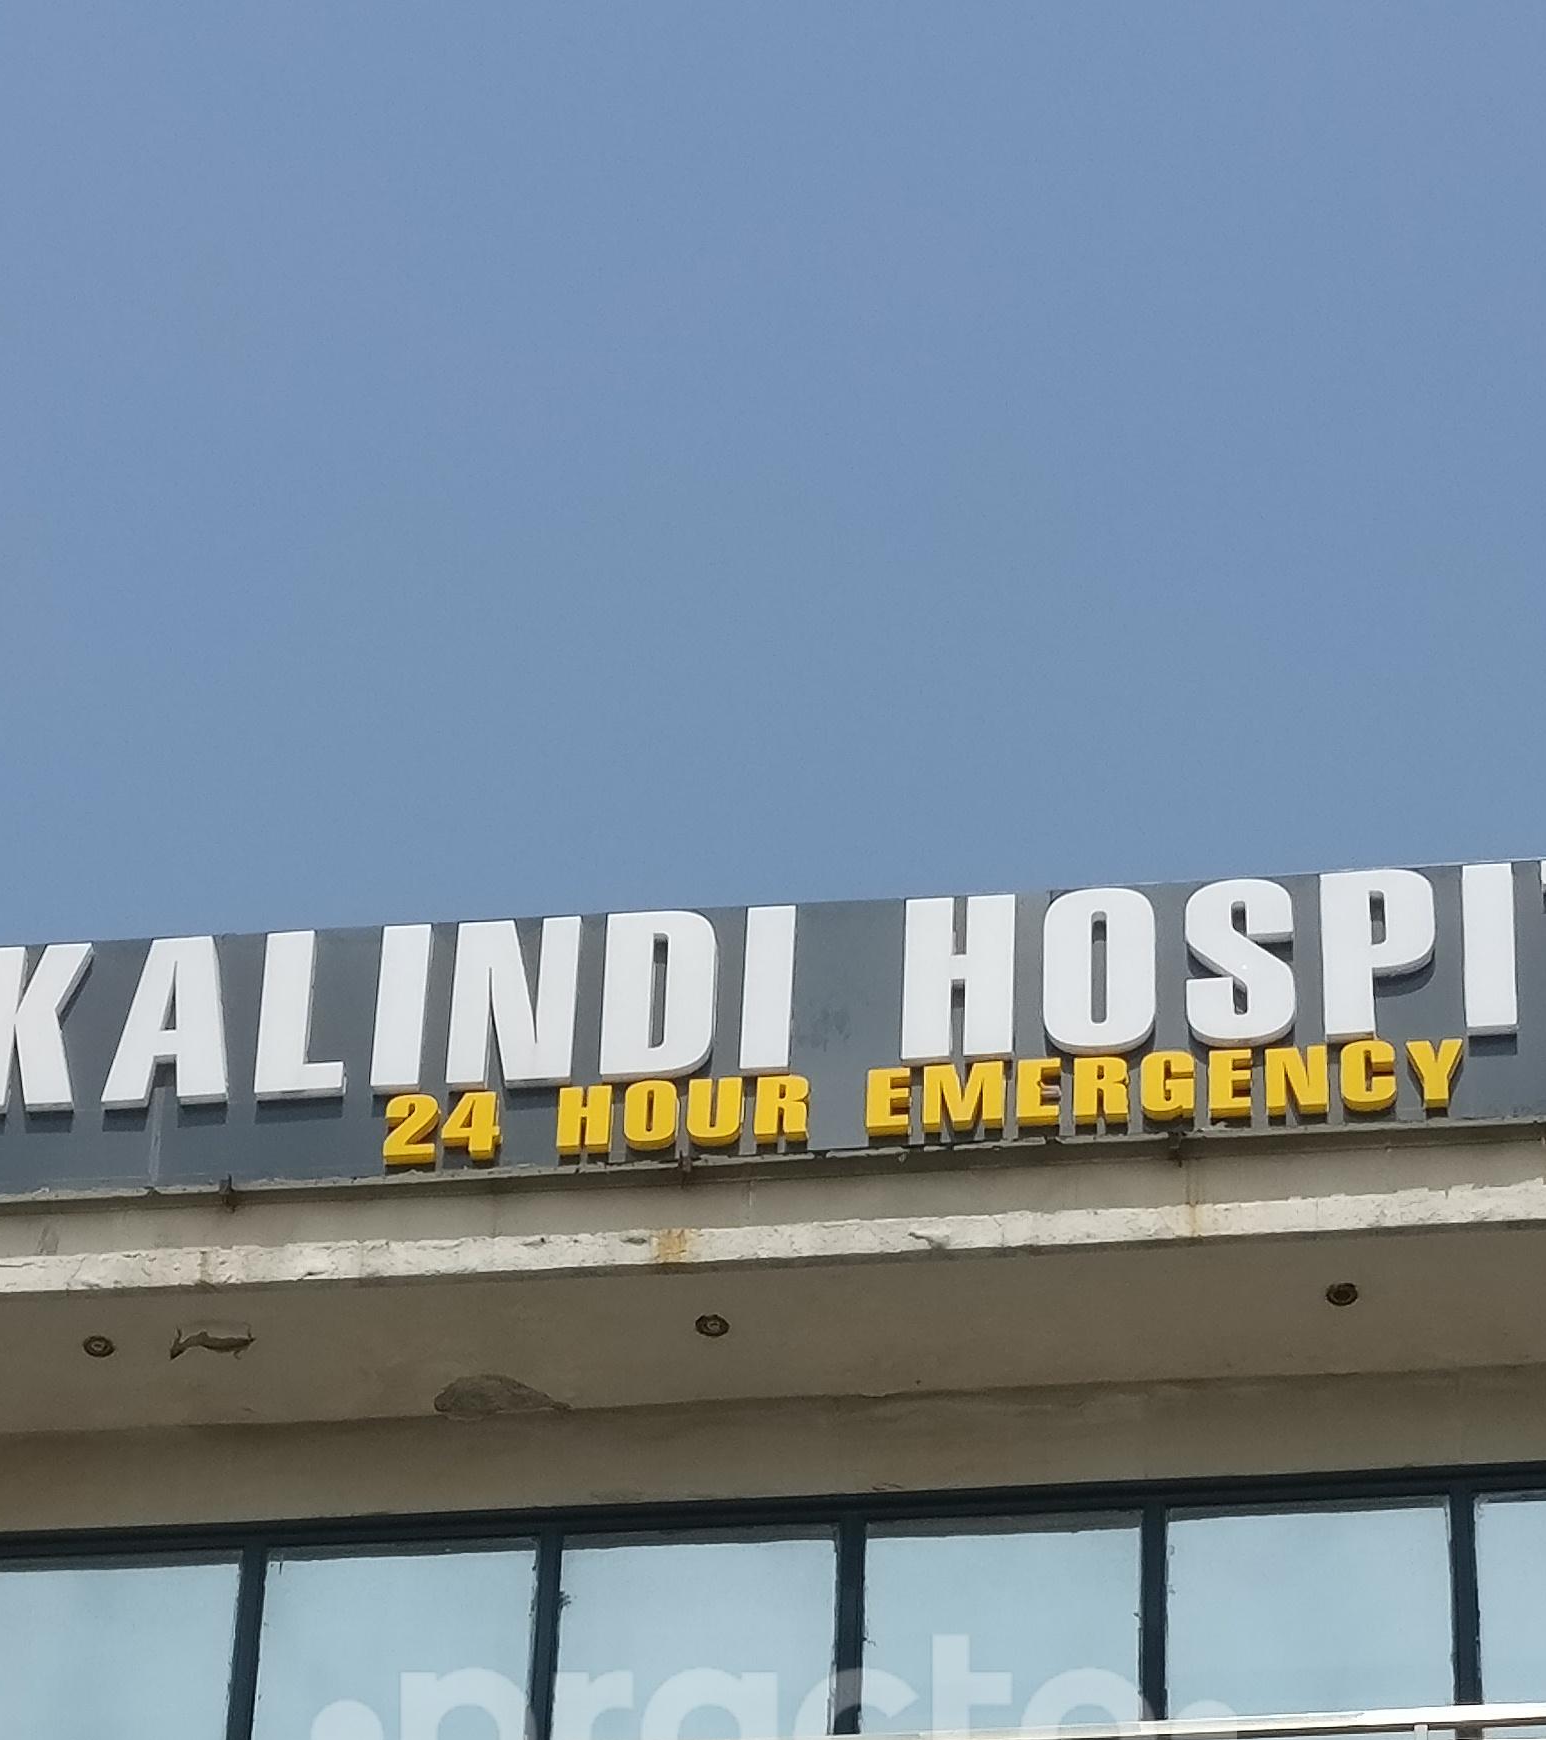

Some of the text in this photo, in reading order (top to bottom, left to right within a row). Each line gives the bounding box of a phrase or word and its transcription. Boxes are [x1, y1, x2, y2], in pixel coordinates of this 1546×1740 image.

[380, 1036, 1464, 1167] 24 HOUR EMERGENCY
